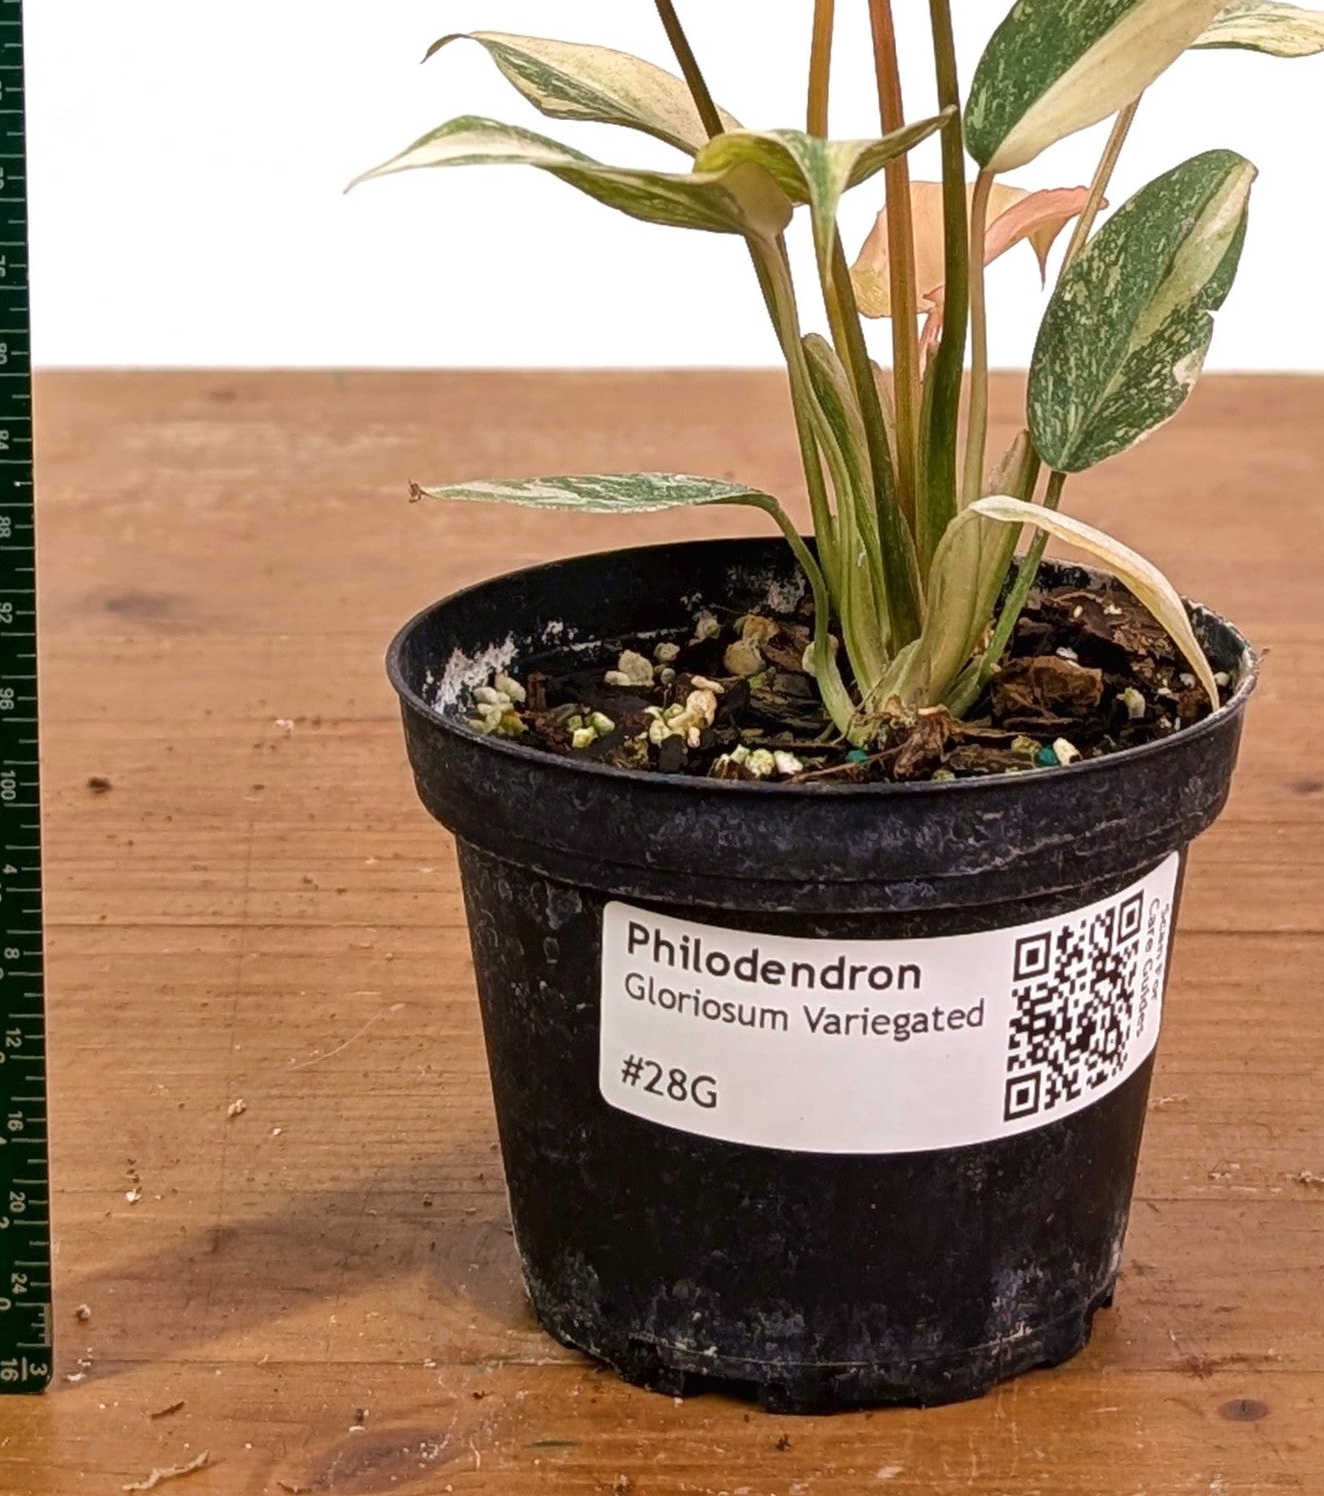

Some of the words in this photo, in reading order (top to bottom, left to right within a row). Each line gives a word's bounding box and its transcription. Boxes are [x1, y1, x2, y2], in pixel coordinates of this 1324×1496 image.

[0, 770, 16, 800] 100
[3, 864, 18, 874] 4
[1145, 898, 1160, 952] Care
[4, 948, 20, 959] 8
[627, 920, 920, 990] Philodendron
[624, 972, 789, 1032] Gloriosum
[804, 998, 985, 1042] Variegated
[6, 1027, 22, 1047] 12
[621, 1053, 718, 1108] #28G
[8, 1111, 24, 1132] 16
[9, 1191, 25, 1213] 20
[11, 1273, 27, 1294] 24
[0, 1358, 19, 1382] 16
[29, 1363, 48, 1376] 3
